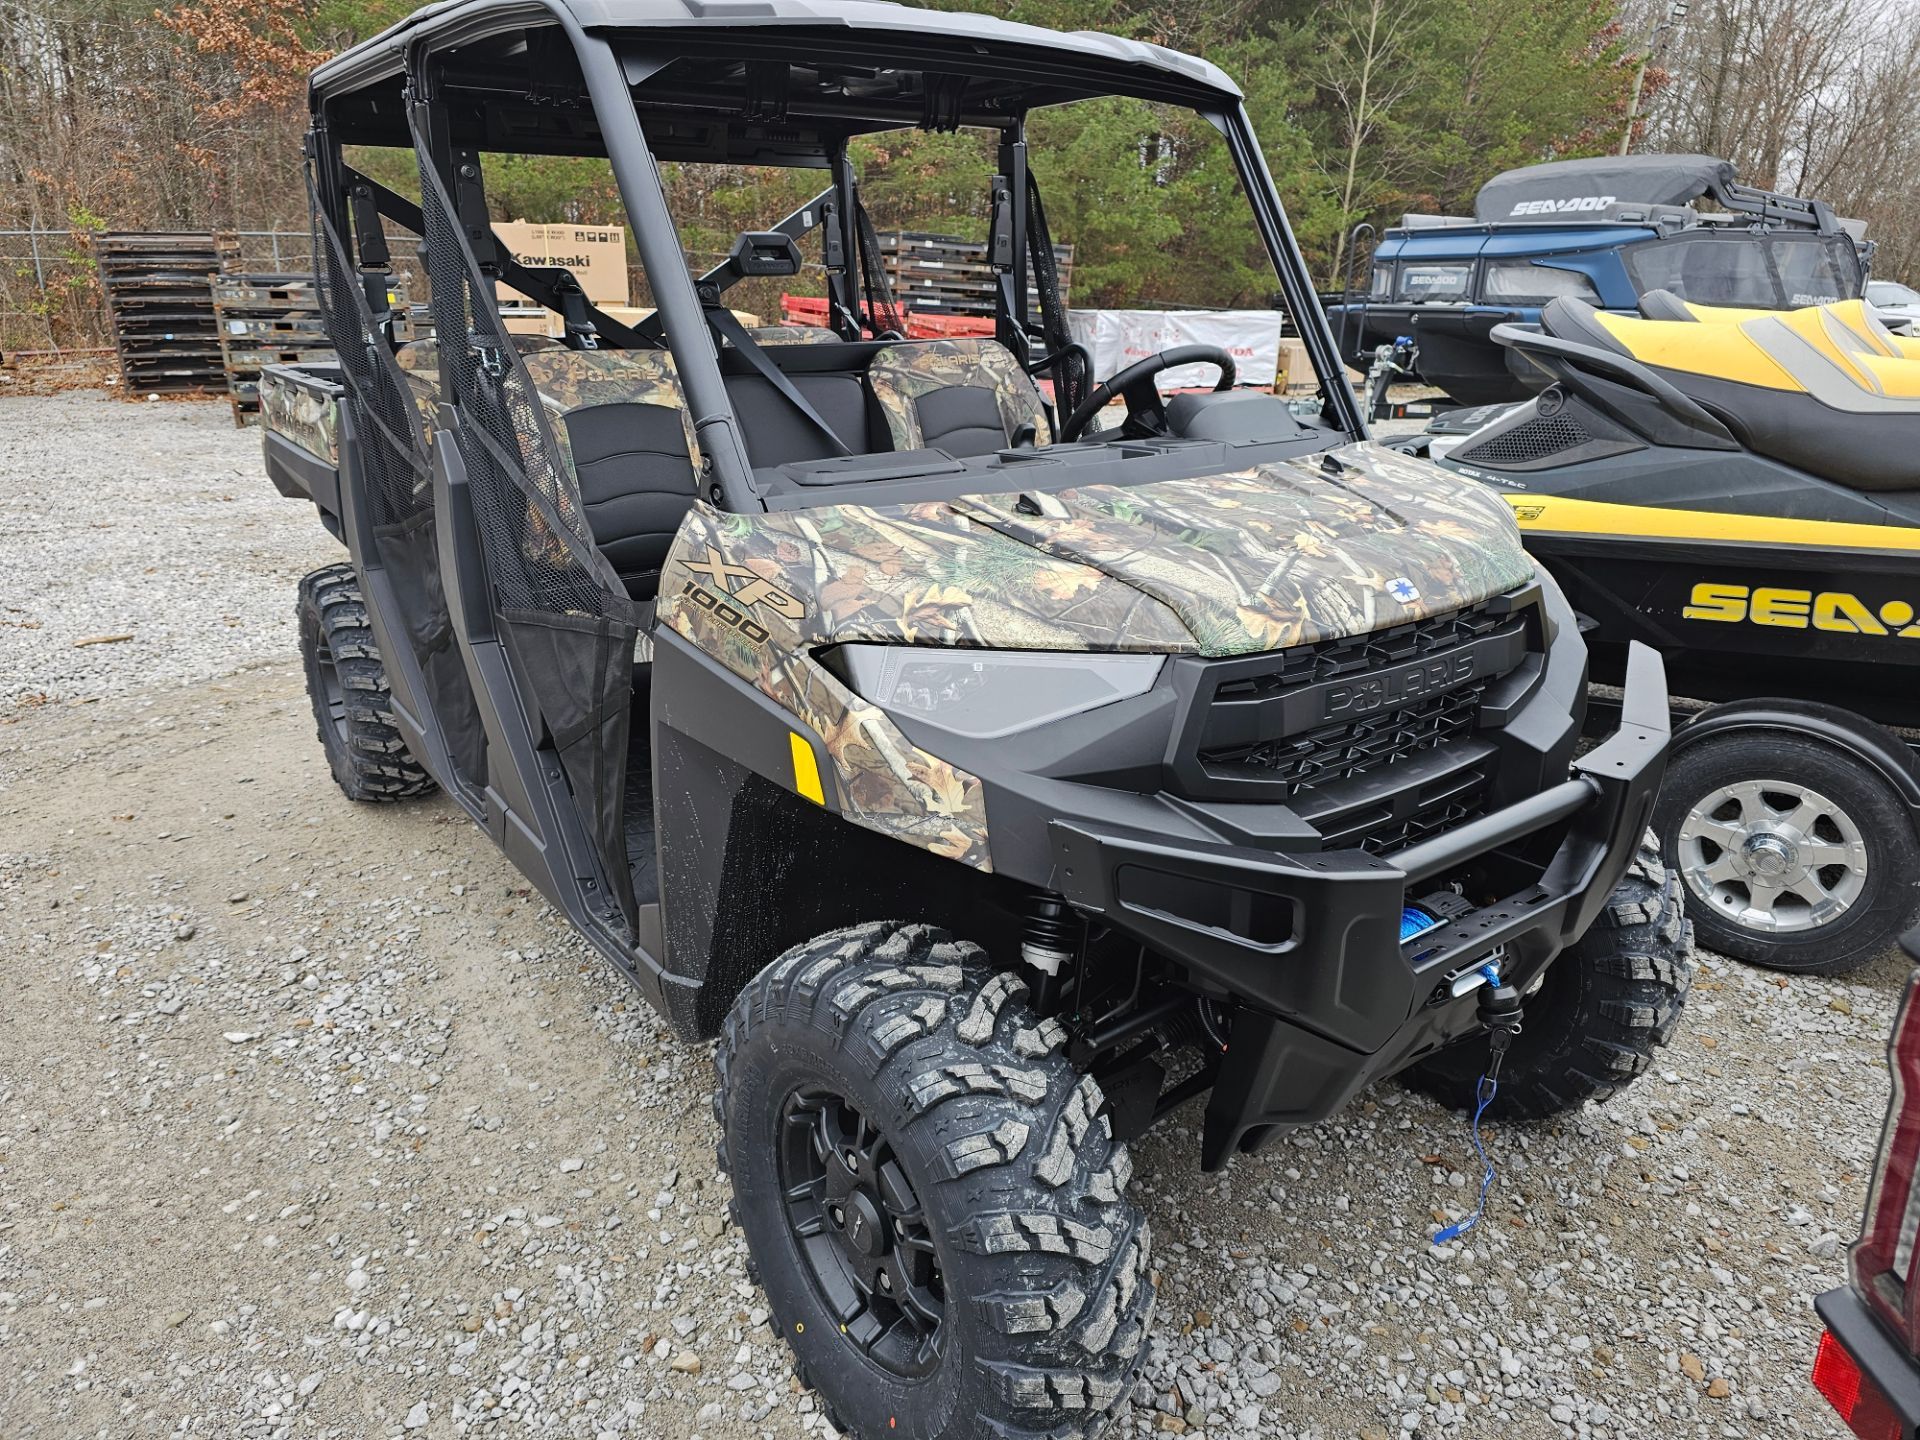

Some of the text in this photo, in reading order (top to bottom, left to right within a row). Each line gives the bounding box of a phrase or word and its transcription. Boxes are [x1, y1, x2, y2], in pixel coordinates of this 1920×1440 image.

[513, 253, 591, 268] Kawasaki
[576, 367, 660, 382] POLARIS
[919, 354, 981, 369] POLARIS
[676, 543, 805, 619] XP
[681, 581, 770, 645] 1000
[1324, 651, 1475, 719] POLARIS
